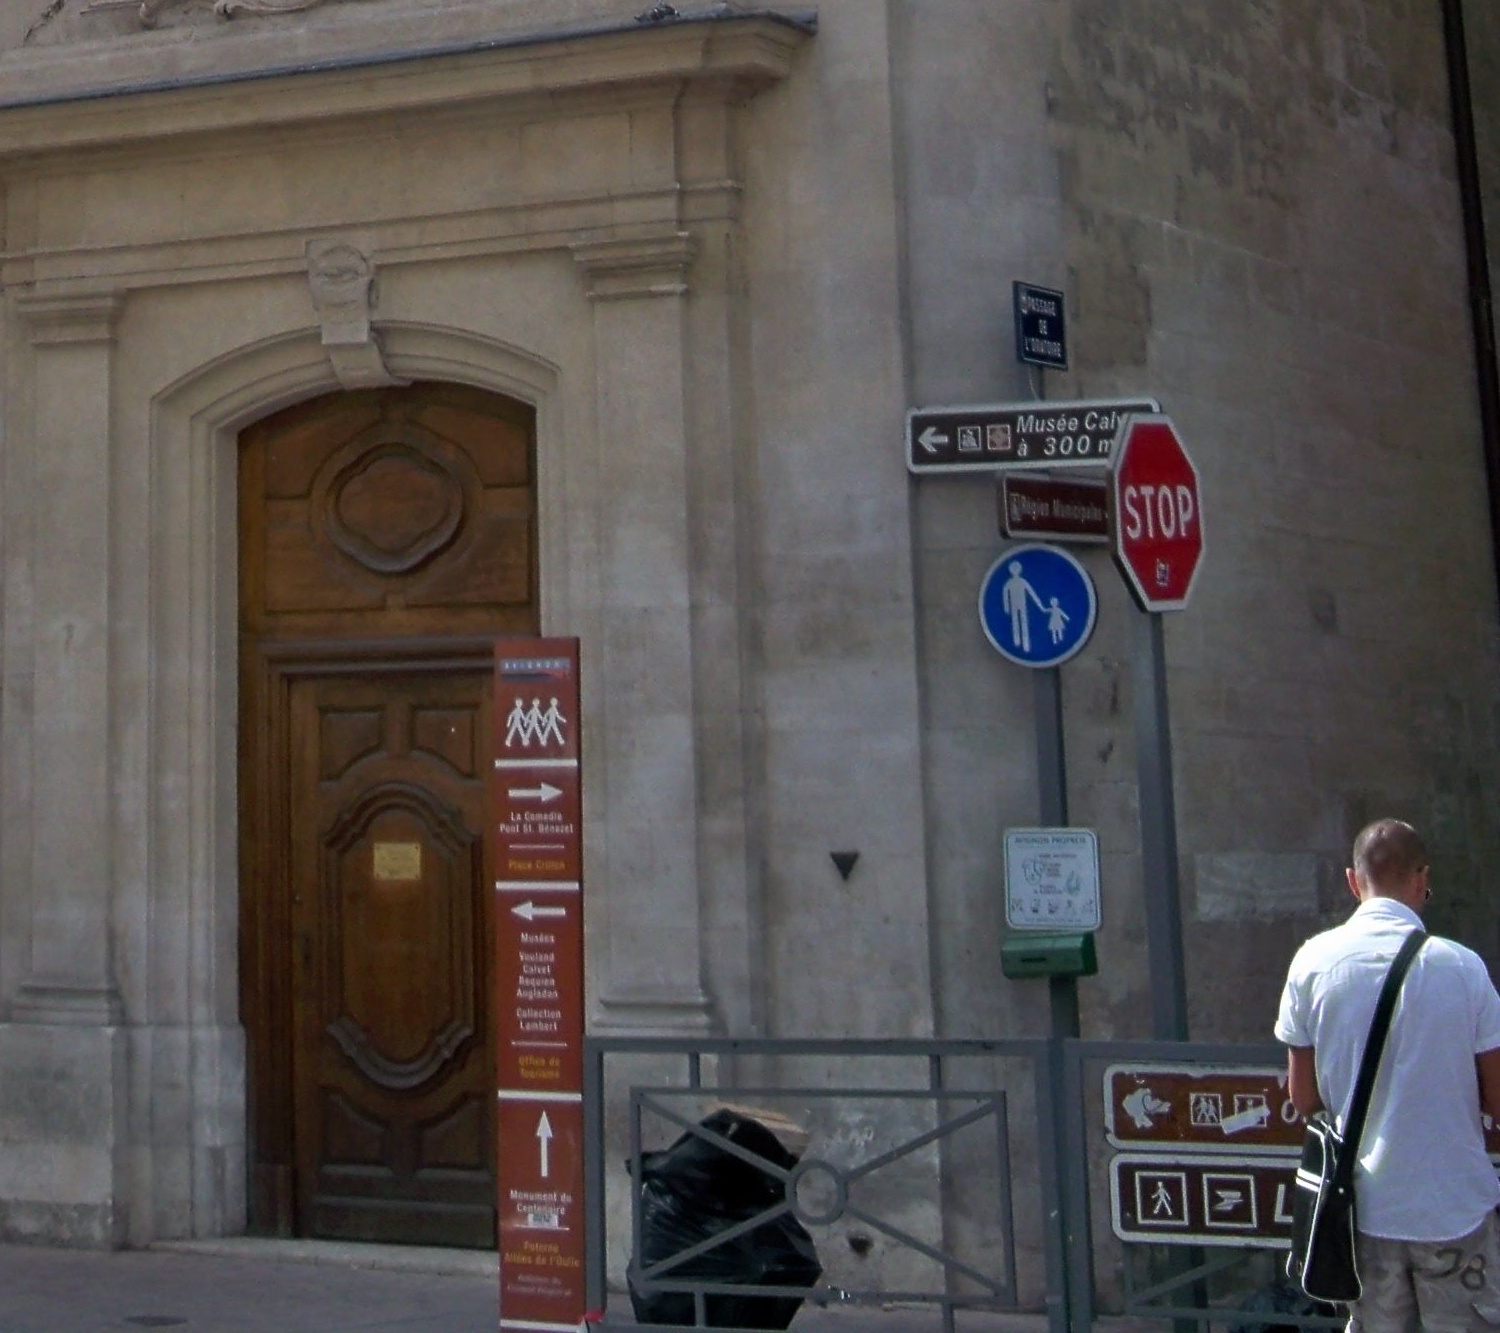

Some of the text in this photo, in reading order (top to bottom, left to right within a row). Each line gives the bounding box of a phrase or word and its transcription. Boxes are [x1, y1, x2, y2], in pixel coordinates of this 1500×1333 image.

[1016, 413, 1079, 434] Musée
[1017, 437, 1028, 457] à
[1043, 434, 1091, 455] 300
[1124, 484, 1193, 540] STOP
[516, 1007, 562, 1019] Collection
[520, 1021, 558, 1031] Lambert
[510, 1189, 572, 1203] Monument du
[516, 1203, 566, 1215] Centenaire
